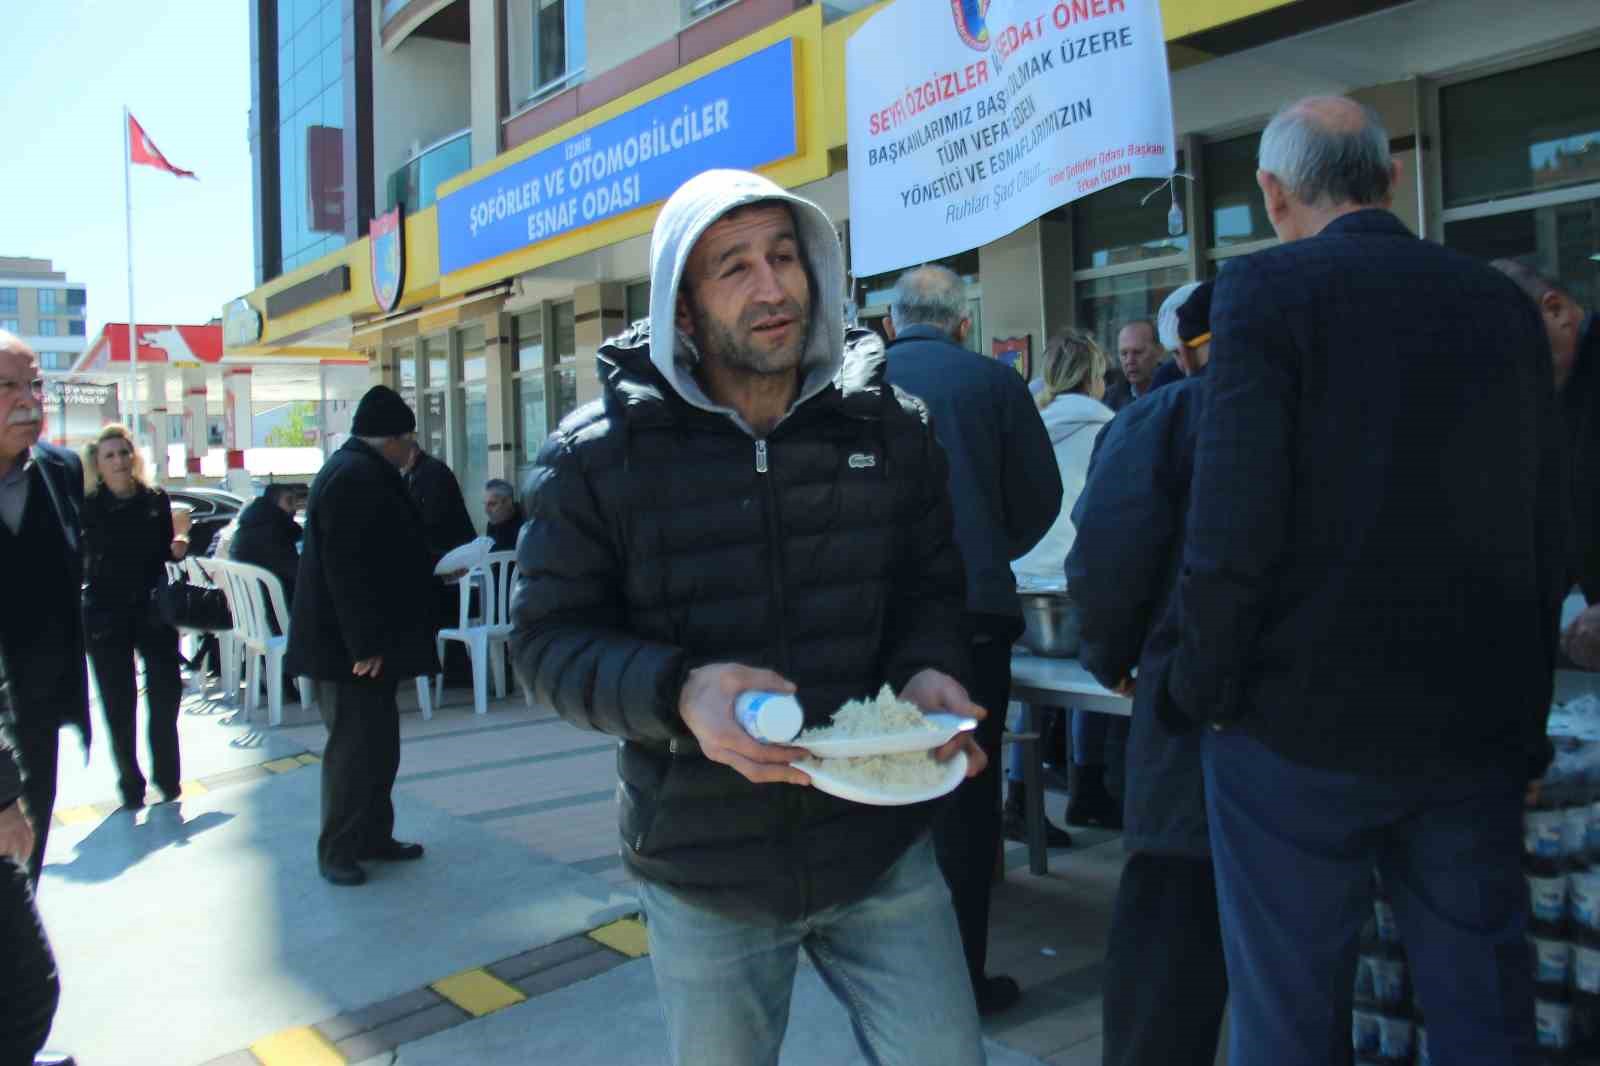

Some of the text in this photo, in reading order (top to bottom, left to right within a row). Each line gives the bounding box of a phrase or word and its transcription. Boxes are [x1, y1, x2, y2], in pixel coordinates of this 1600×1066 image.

[1061, 25, 1134, 64] ÜZERE
[469, 99, 729, 238] ŞOFÖRLER VE OTOMOBİLCİLER
[900, 96, 1093, 209] YÖNETİCİ VE ESNAFLARIMIZIN
[936, 135, 968, 167] TÜM
[527, 174, 641, 241] ESNAF ODASI
